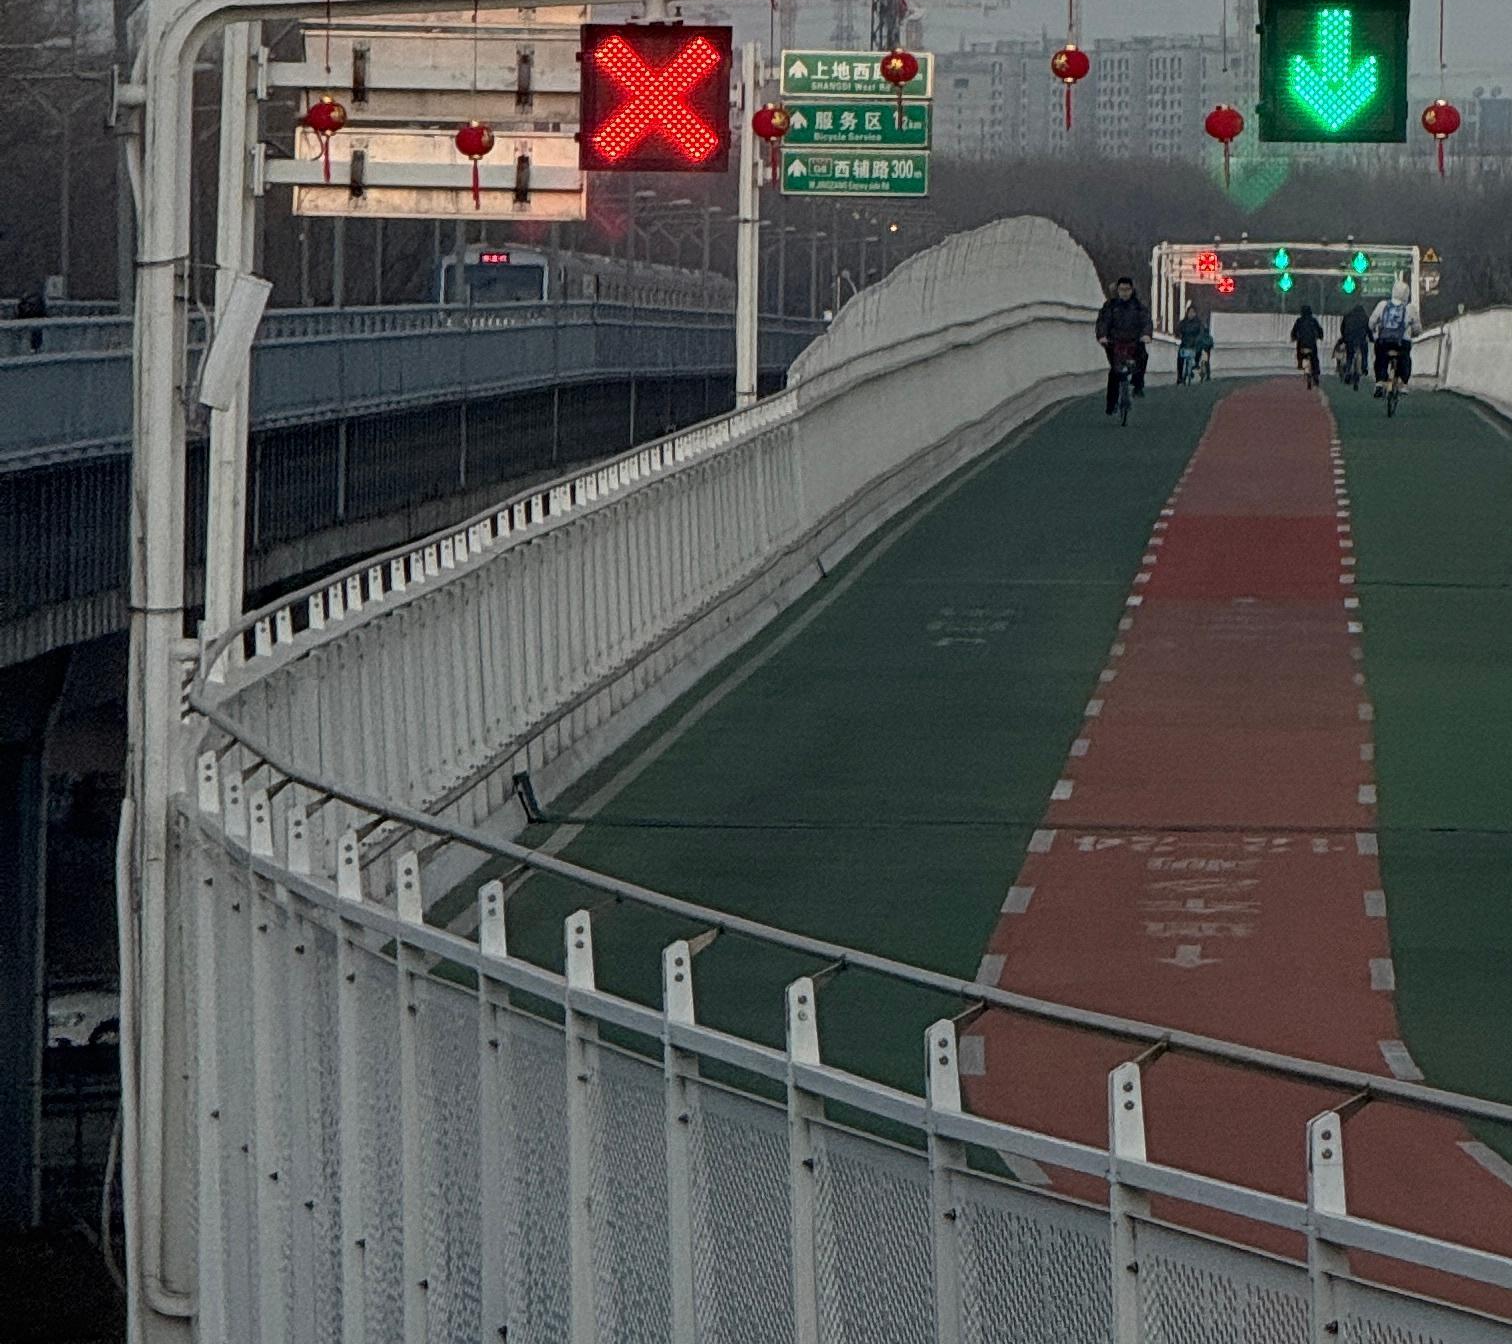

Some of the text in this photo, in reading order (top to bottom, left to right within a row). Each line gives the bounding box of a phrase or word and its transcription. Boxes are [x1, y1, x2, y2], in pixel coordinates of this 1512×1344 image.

[811, 81, 851, 91] SHANGDI
[854, 83, 876, 92] West
[815, 111, 882, 131] 服务区
[814, 132, 882, 142] Bicycle Service
[834, 159, 889, 179] 西辅路
